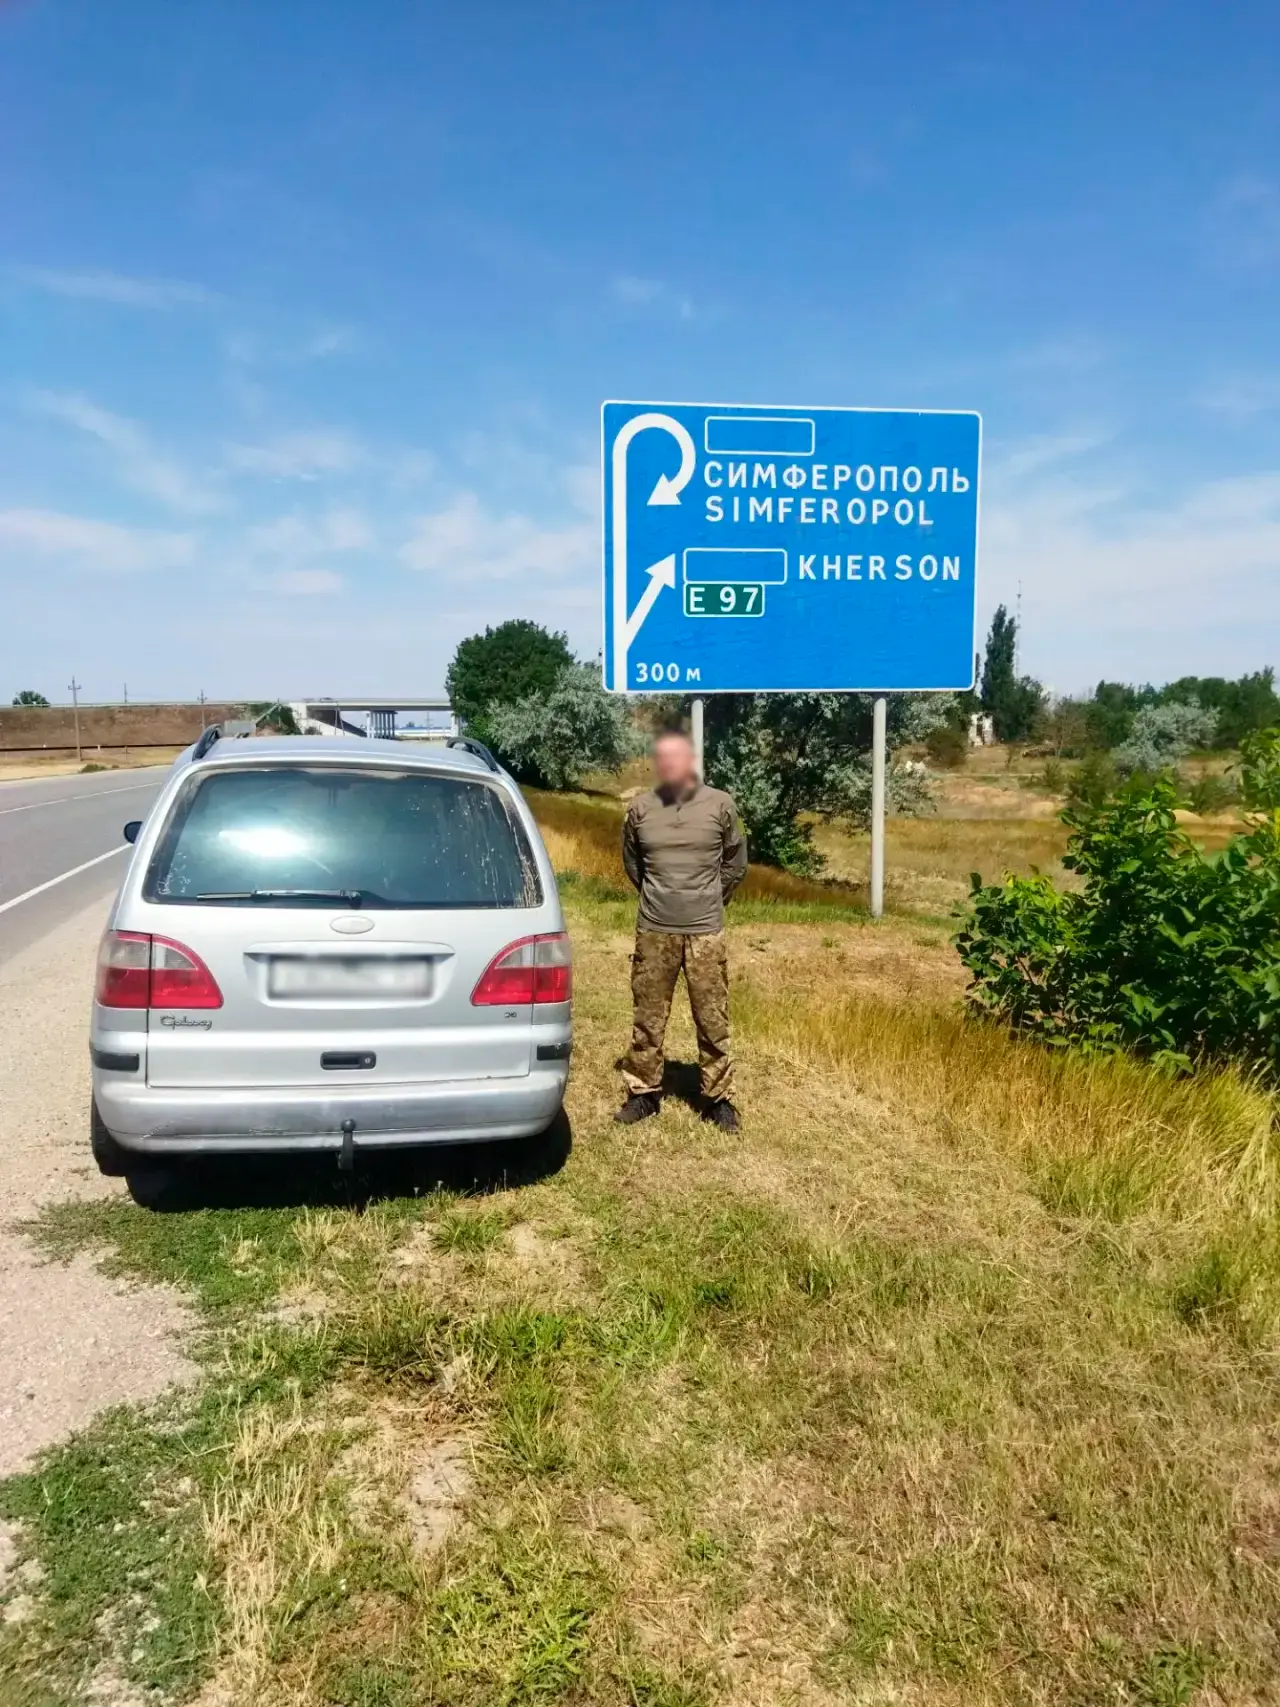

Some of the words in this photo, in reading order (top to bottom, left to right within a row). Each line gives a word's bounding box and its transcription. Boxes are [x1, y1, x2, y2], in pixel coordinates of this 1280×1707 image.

[704, 461, 970, 493] СИМФЕРОПОЛЬ
[705, 496, 934, 525] SIMFEROPOL
[799, 554, 960, 581] KHERSON
[689, 587, 705, 612] E
[719, 587, 760, 613] 97
[636, 662, 680, 682] 300
